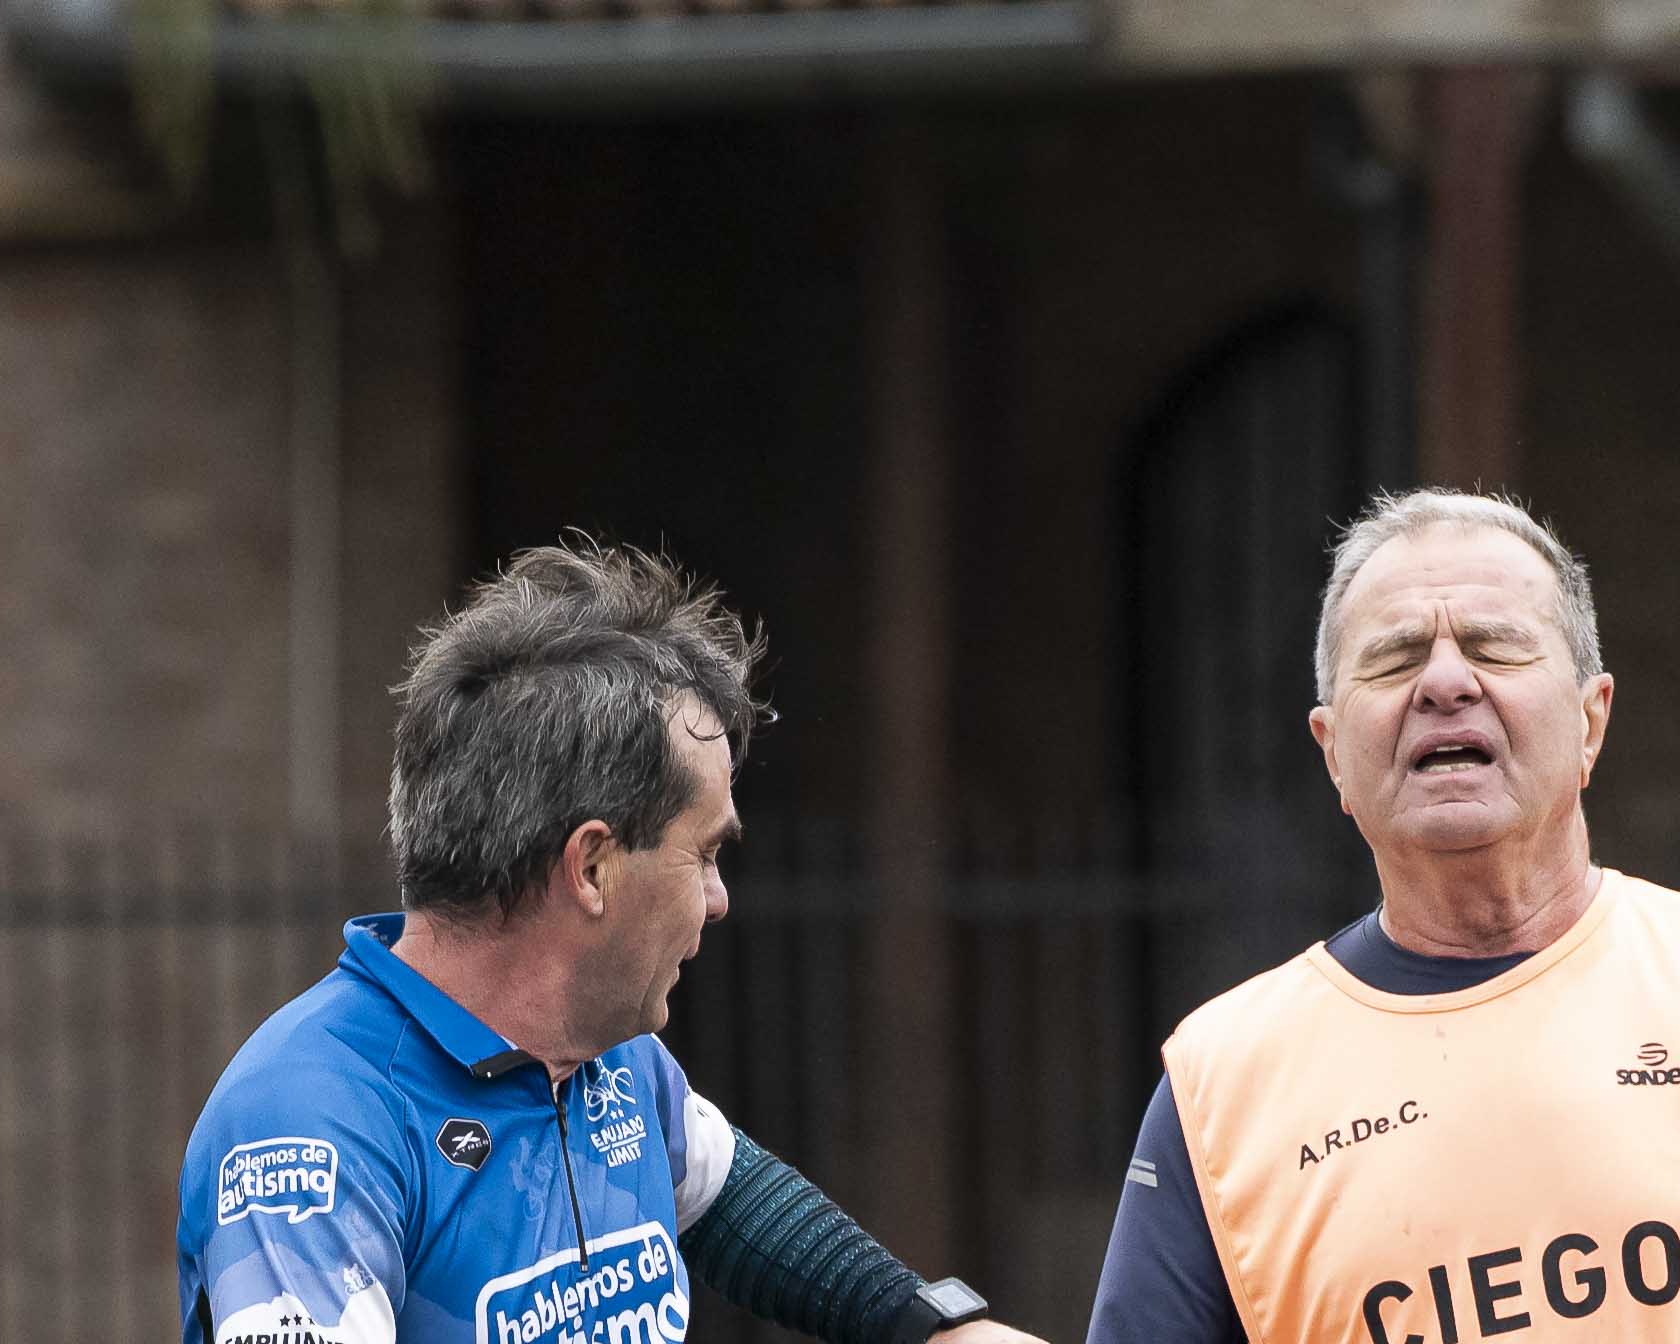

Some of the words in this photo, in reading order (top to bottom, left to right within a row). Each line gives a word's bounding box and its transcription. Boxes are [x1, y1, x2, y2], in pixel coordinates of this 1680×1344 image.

[1299, 1100, 1429, 1171] A.R.De.C.
[224, 1147, 298, 1186] hablemos
[300, 1143, 328, 1163] de
[221, 1166, 330, 1214] autismo
[637, 1236, 668, 1283] de
